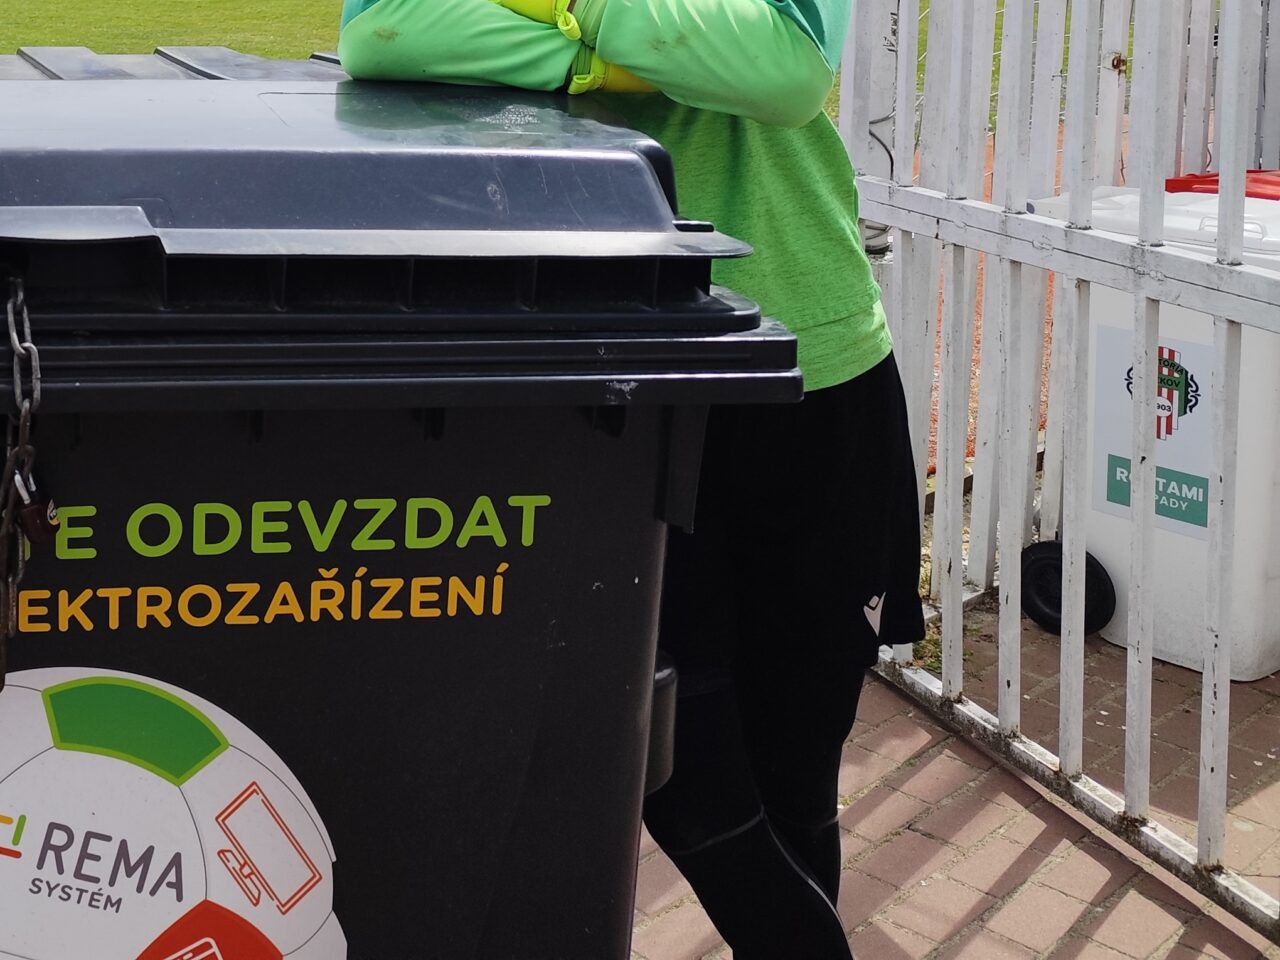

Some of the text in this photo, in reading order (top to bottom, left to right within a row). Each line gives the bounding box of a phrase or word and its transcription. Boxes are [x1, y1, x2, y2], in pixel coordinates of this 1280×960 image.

[126, 494, 552, 558] ODEVZDAT
[35, 821, 184, 903] REMA
[28, 877, 124, 914] SYSTÉM
